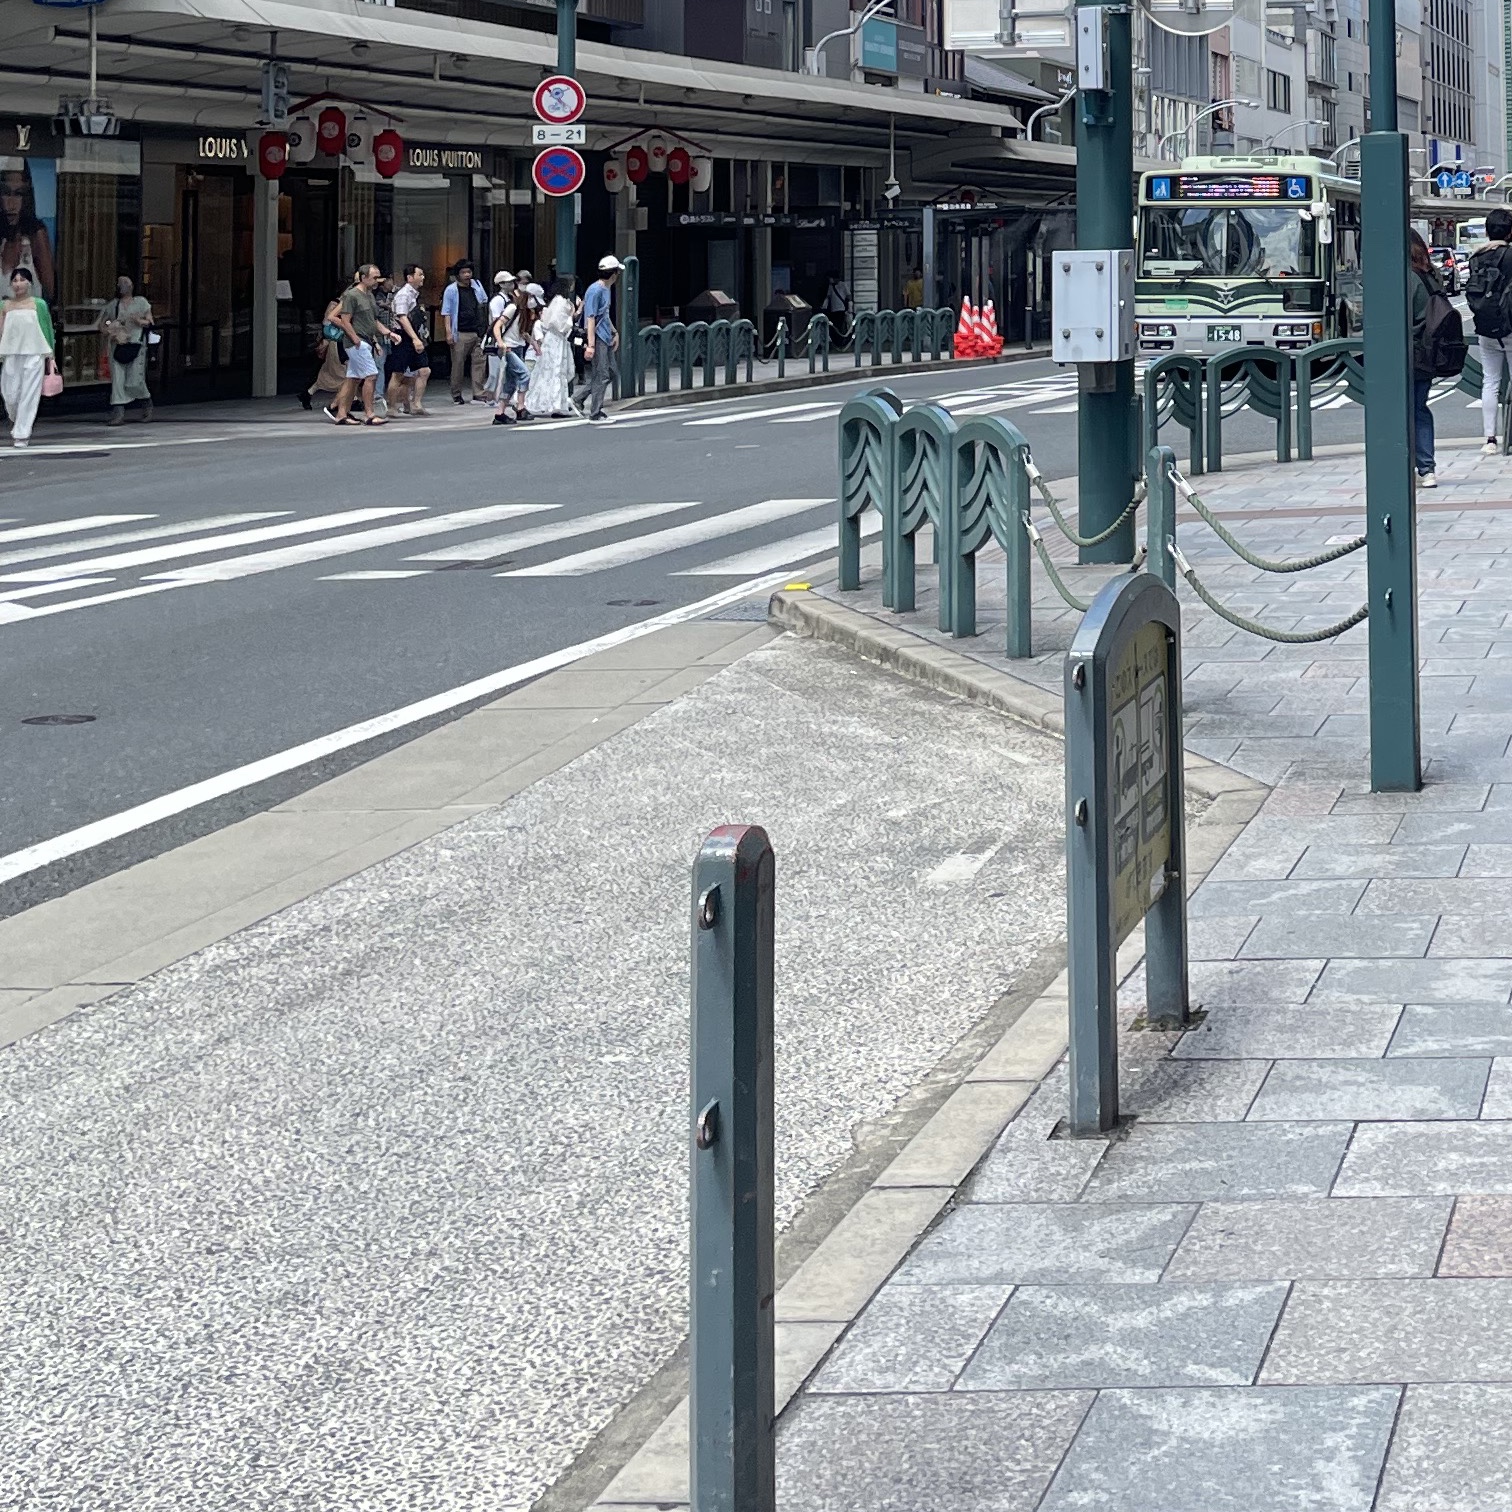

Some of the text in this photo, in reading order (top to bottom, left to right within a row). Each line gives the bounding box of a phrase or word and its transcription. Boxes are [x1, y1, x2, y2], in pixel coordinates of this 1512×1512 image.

[199, 137, 237, 158] LOUIS
[409, 148, 482, 169] LOUIS VUITTON
